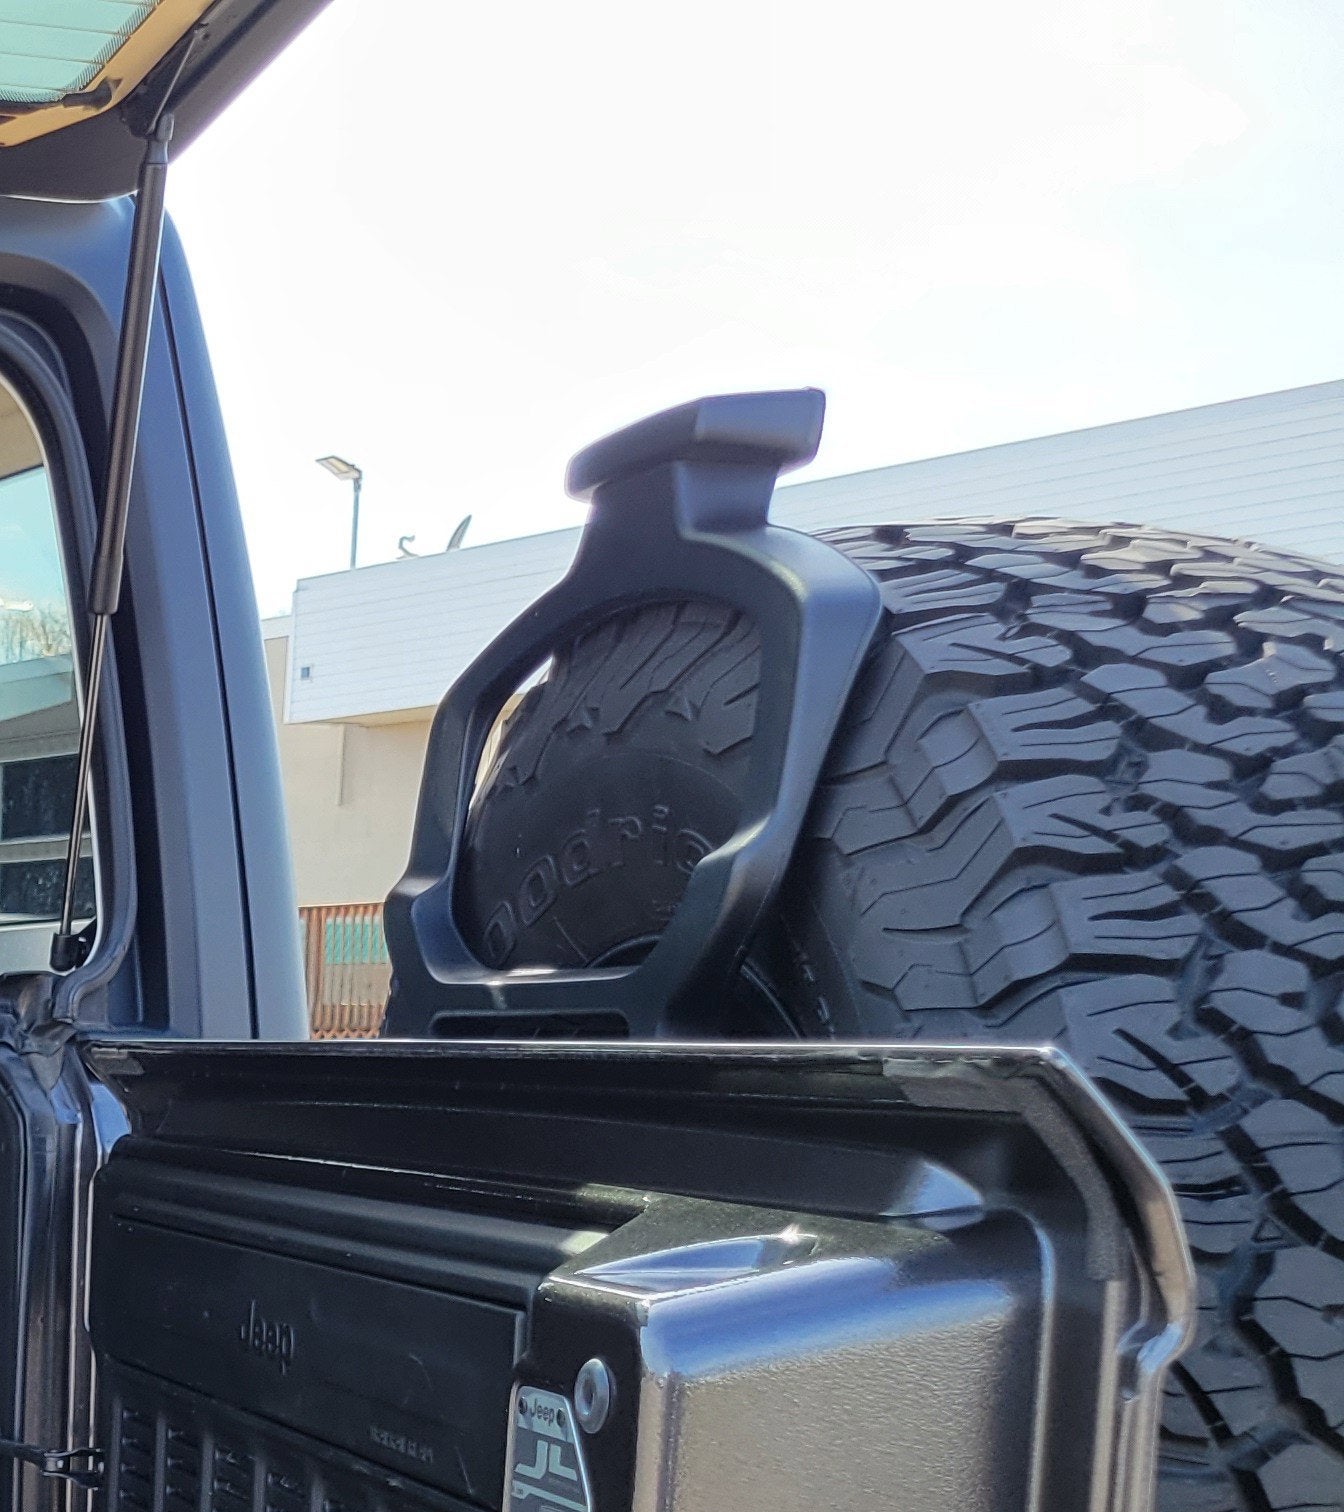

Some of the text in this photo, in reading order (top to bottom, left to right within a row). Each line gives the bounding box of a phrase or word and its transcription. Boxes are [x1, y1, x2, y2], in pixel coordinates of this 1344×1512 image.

[240, 1300, 295, 1376] Jeep
[530, 1398, 555, 1427] Jeep
[514, 1439, 578, 1482] JL
